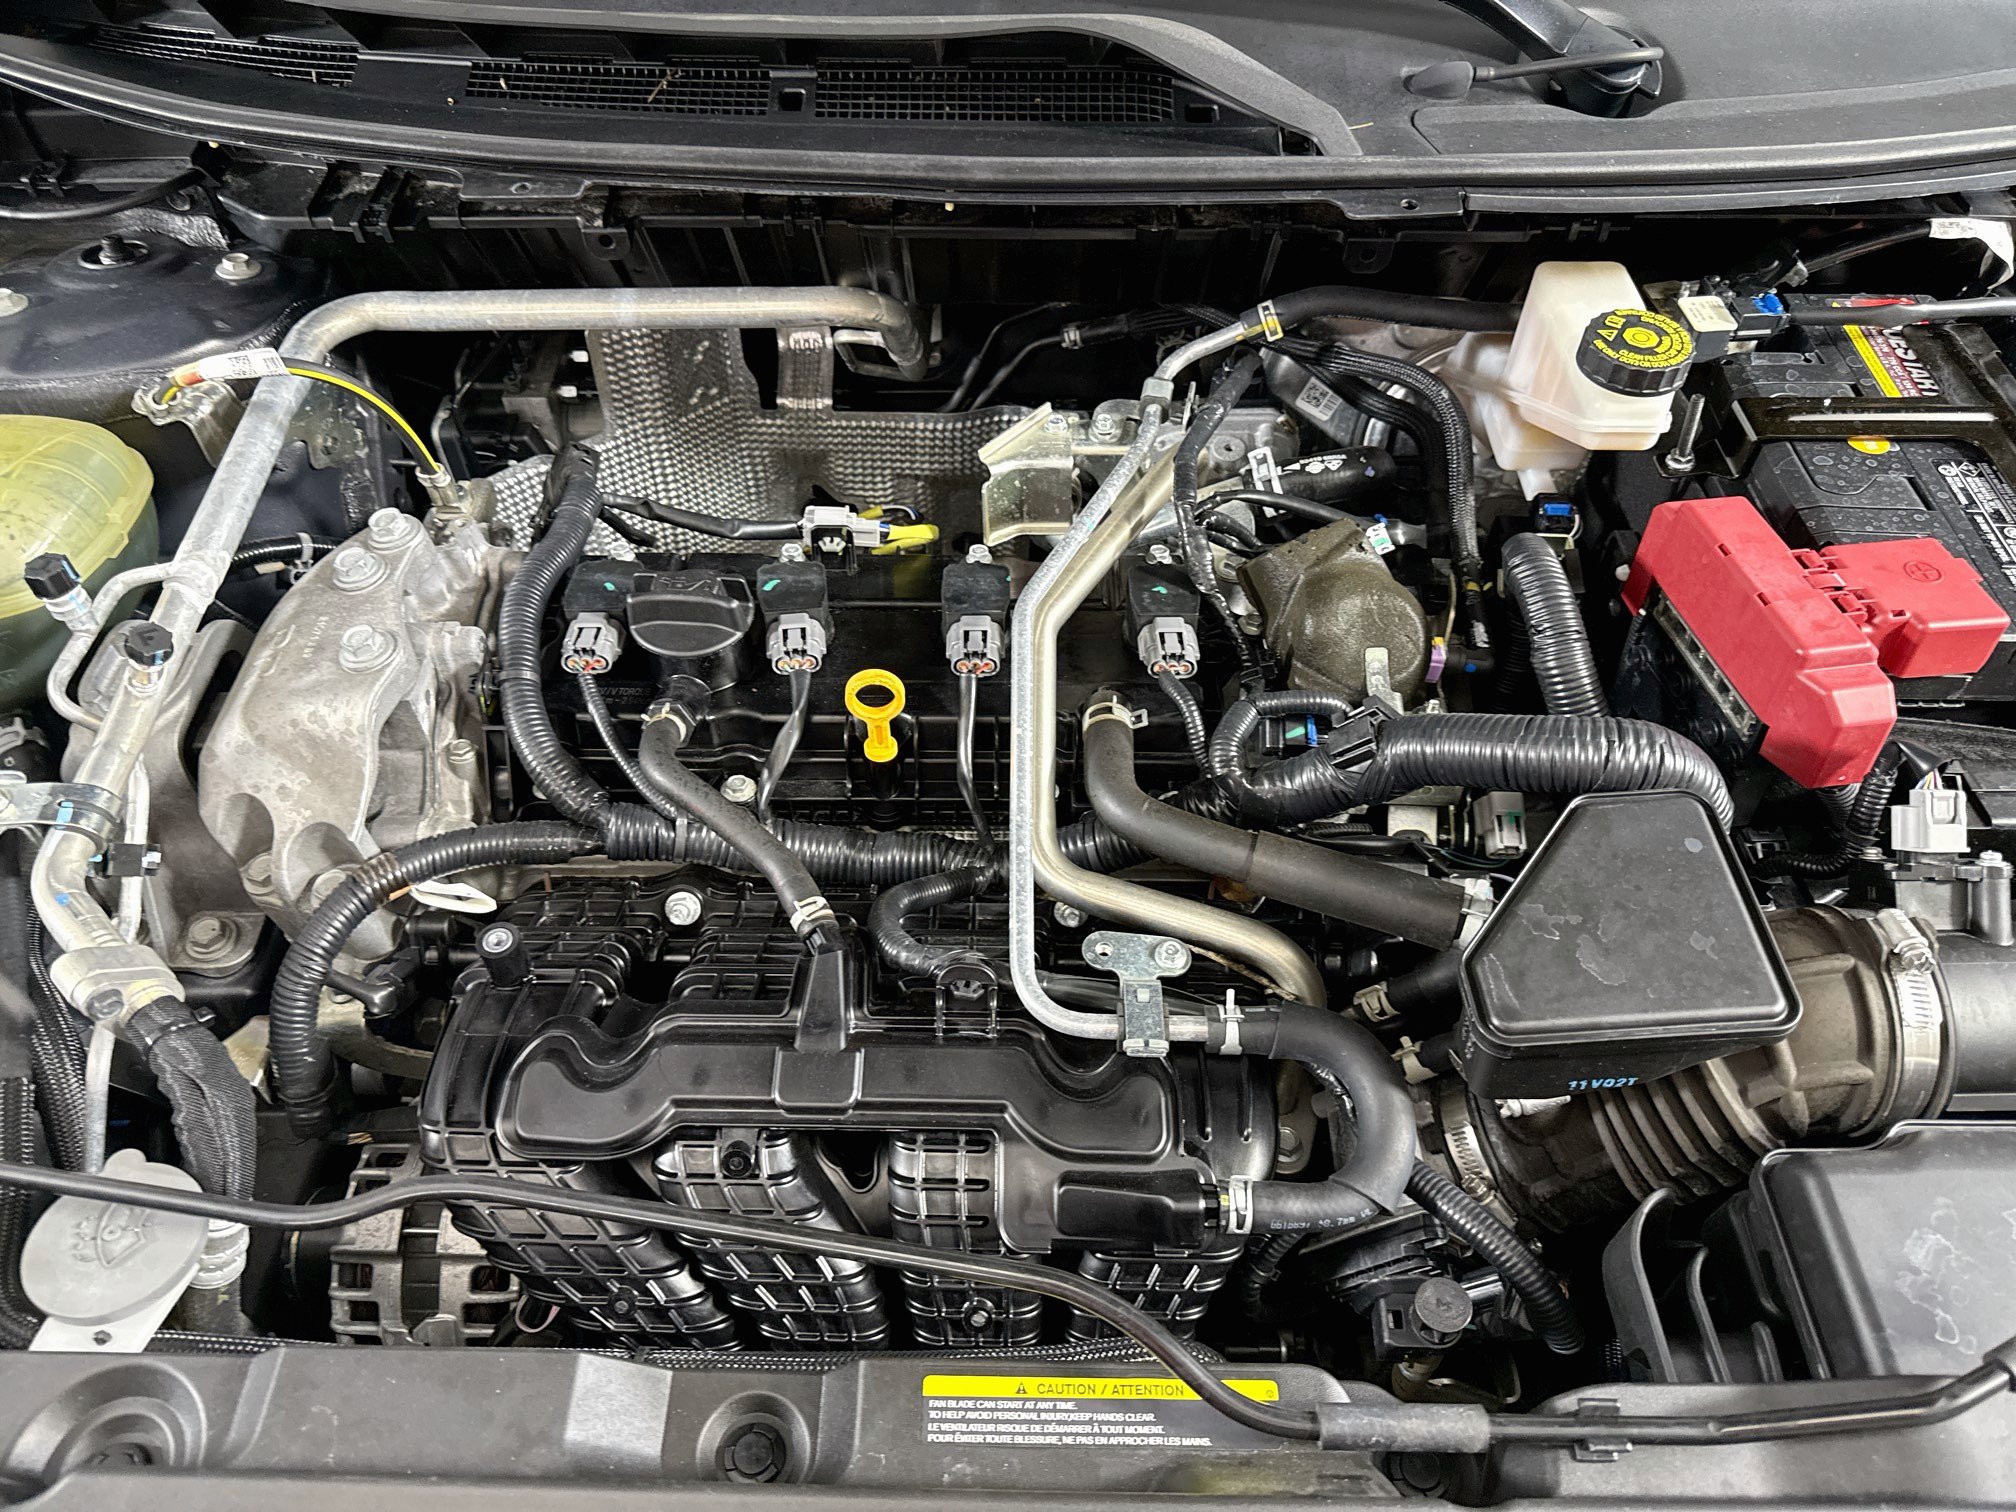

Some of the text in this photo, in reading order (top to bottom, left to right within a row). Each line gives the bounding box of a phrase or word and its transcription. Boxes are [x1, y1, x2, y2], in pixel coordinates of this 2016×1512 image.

[1602, 347, 1620, 359] ONLY
[1653, 313, 1680, 328] SEALED
[1618, 350, 1644, 361] CLEAN
[1644, 353, 1668, 361] FILLER
[1038, 1384, 1184, 1396] CAUTION / ATTENTION
[947, 1400, 976, 1408] BLADE
[976, 1400, 996, 1408] CAN
[996, 1401, 1024, 1409] START
[928, 1410, 942, 1418] TO
[965, 1411, 992, 1419] AVOID
[993, 1412, 1040, 1420] PERSONAL
[1092, 1413, 1124, 1421] HANDS
[928, 1422, 940, 1431] LE
[940, 1423, 996, 1432] VENTILATEUR
[996, 1424, 1030, 1432] RISQUE
[1030, 1424, 1044, 1432] DE
[1044, 1422, 1092, 1433] DÉMARRER
[1100, 1425, 1124, 1433] TOUT
[1125, 1426, 1166, 1434] MOMENT.
[928, 1434, 954, 1442] POUR
[954, 1432, 985, 1442] ÉVITER
[984, 1434, 1013, 1443] TOUTE
[1013, 1435, 1062, 1445] BLESSURE,
[1062, 1436, 1076, 1444] NE
[1076, 1436, 1094, 1444] PAS
[1095, 1436, 1108, 1444] EN
[1108, 1436, 1164, 1445] APPROCHER
[1164, 1437, 1182, 1445] LES
